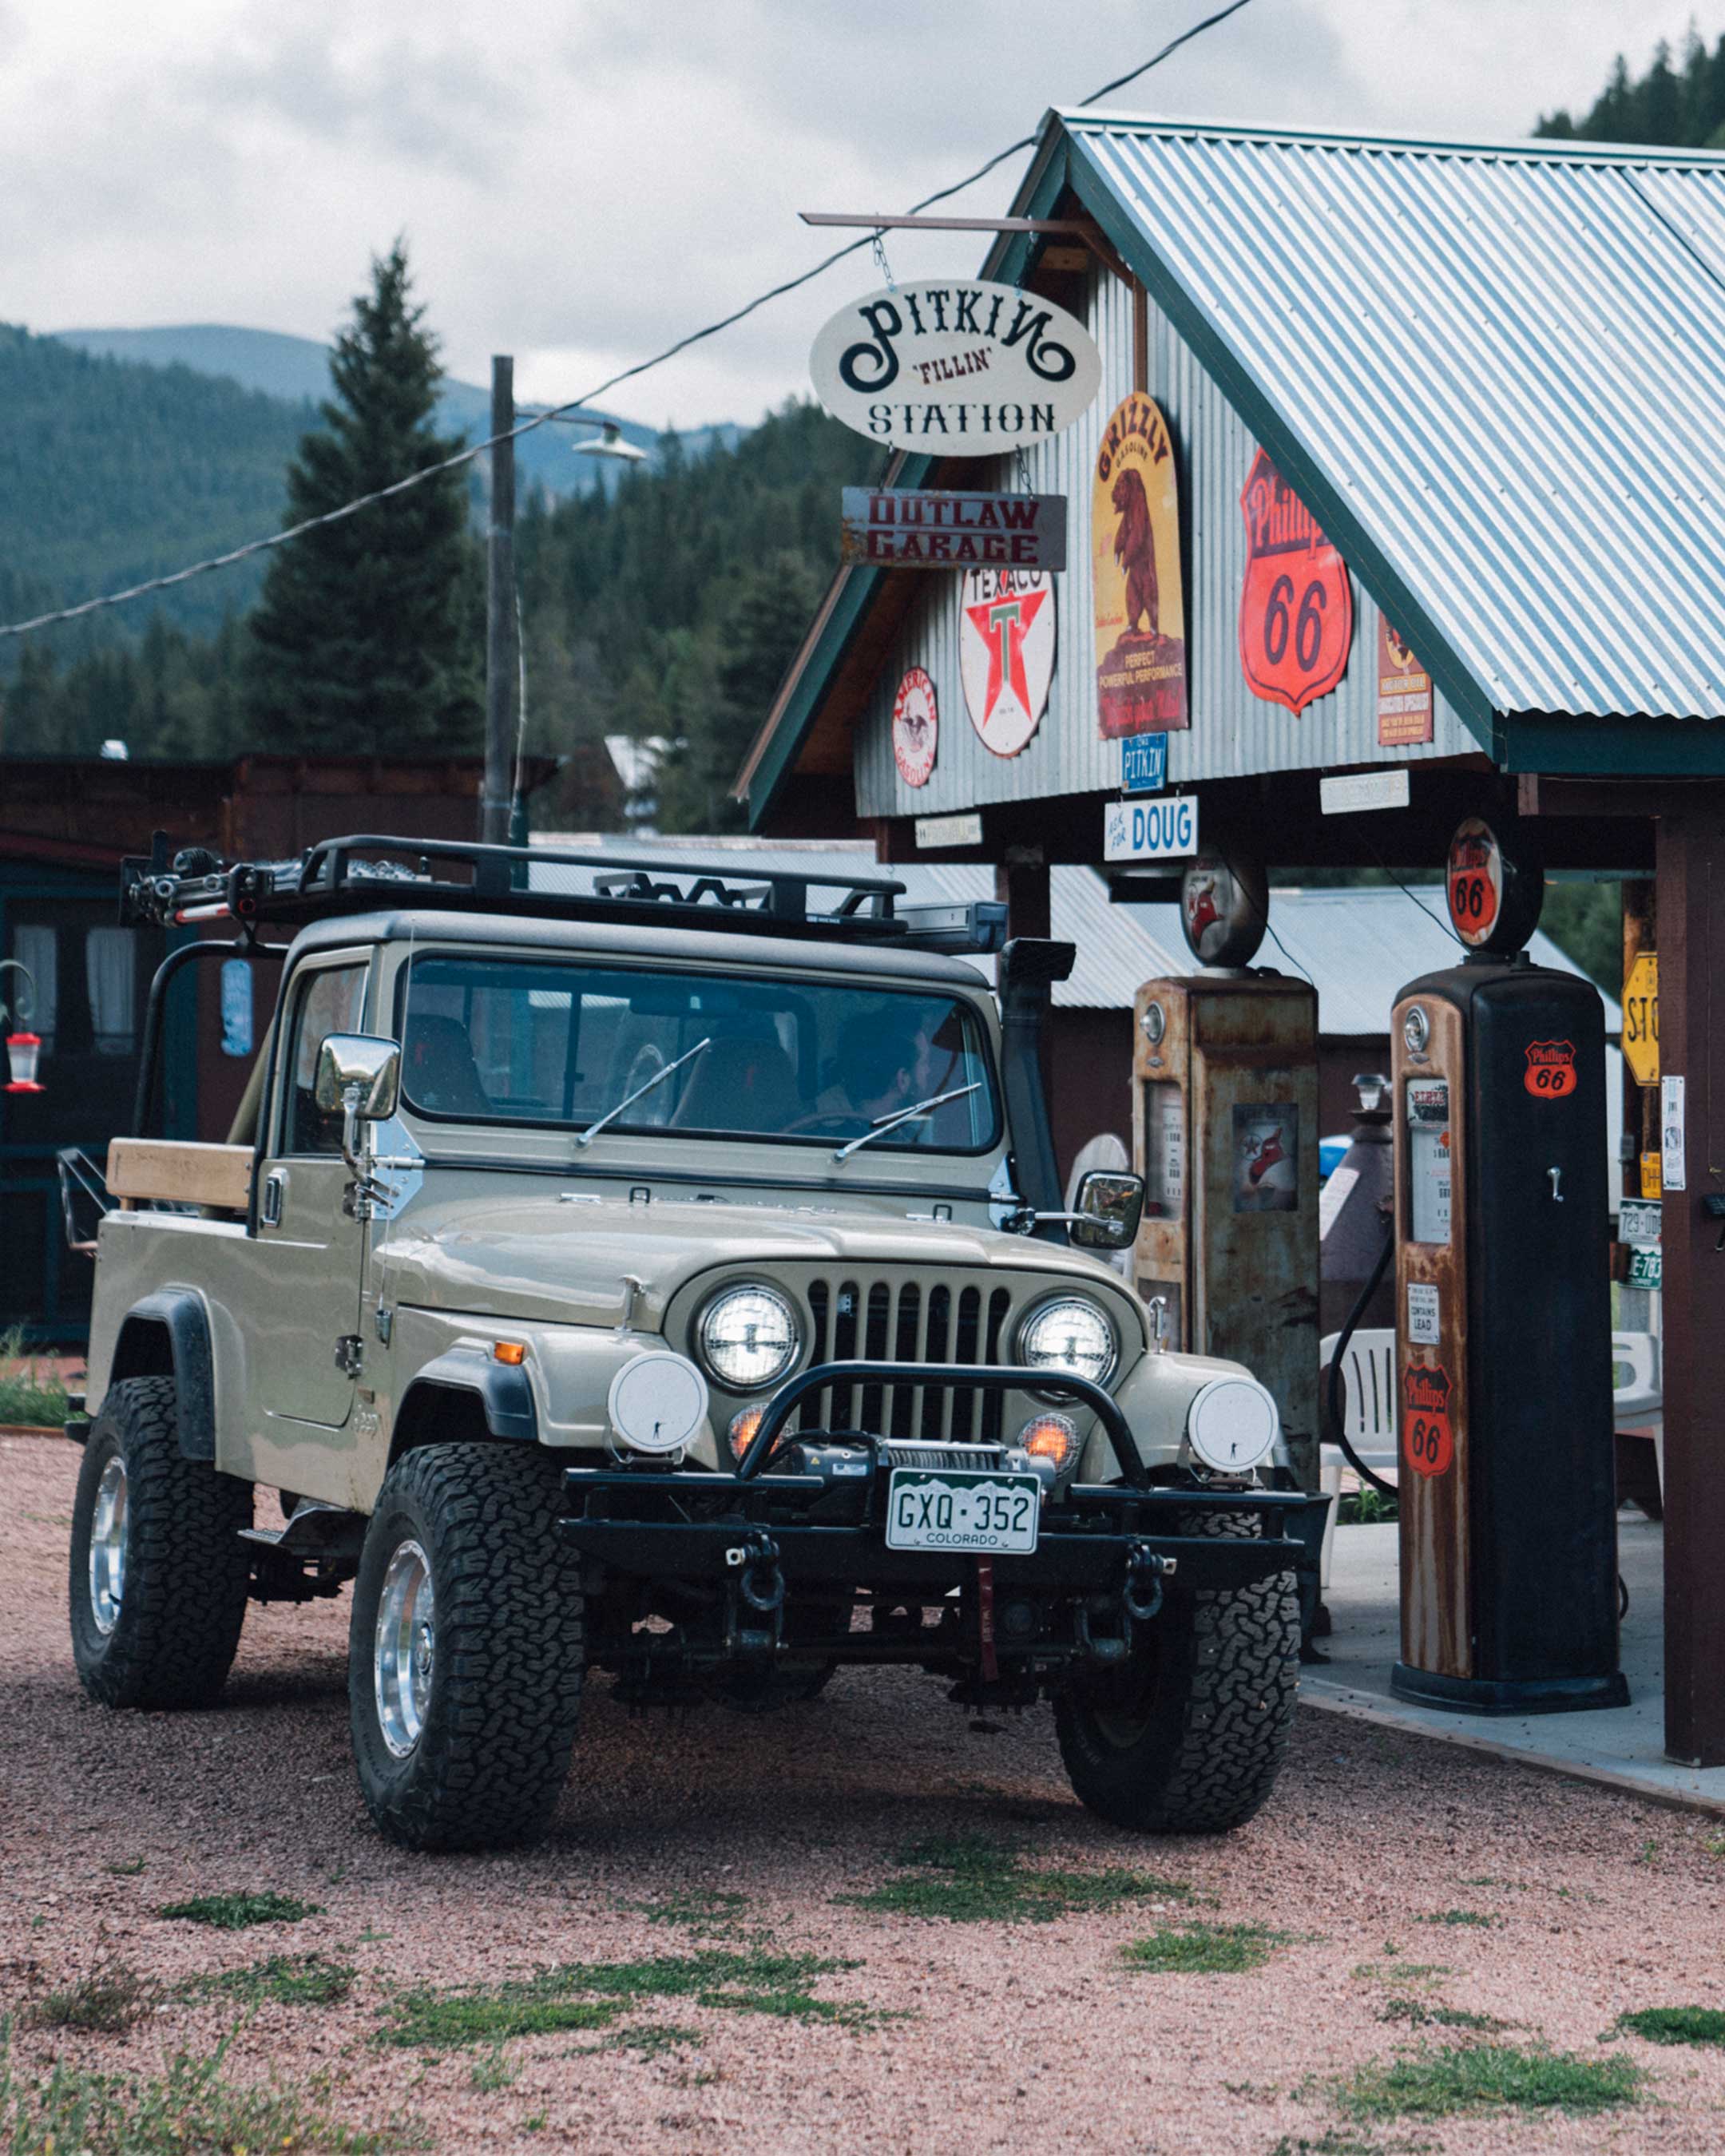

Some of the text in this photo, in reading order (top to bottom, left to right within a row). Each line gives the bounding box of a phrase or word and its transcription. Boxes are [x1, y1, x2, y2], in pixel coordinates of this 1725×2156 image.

[839, 288, 1076, 394] PITKIN
[868, 403, 1055, 434] STATION
[1098, 401, 1169, 482] GRIZZLY
[869, 495, 1040, 530] OUTLAW
[867, 529, 1039, 565] GARAGE
[970, 569, 1041, 601] TEXACO
[1263, 574, 1327, 672] 66
[1099, 663, 1182, 689] POWERFUL PERFORMANCE
[1124, 650, 1155, 668] PERFECT
[894, 669, 936, 720] AMERICAN
[896, 746, 934, 784] GASOLINE
[1124, 747, 1164, 779] PITKIN
[1132, 803, 1192, 850] DOUG
[1456, 877, 1484, 917] 66
[1531, 1048, 1570, 1067] Phillips
[1537, 1068, 1565, 1091] 66
[1414, 1319, 1432, 1331] LEAD
[1406, 1375, 1445, 1417] Phillips
[1412, 1418, 1441, 1464] 66
[926, 1533, 997, 1546] COLORADO
